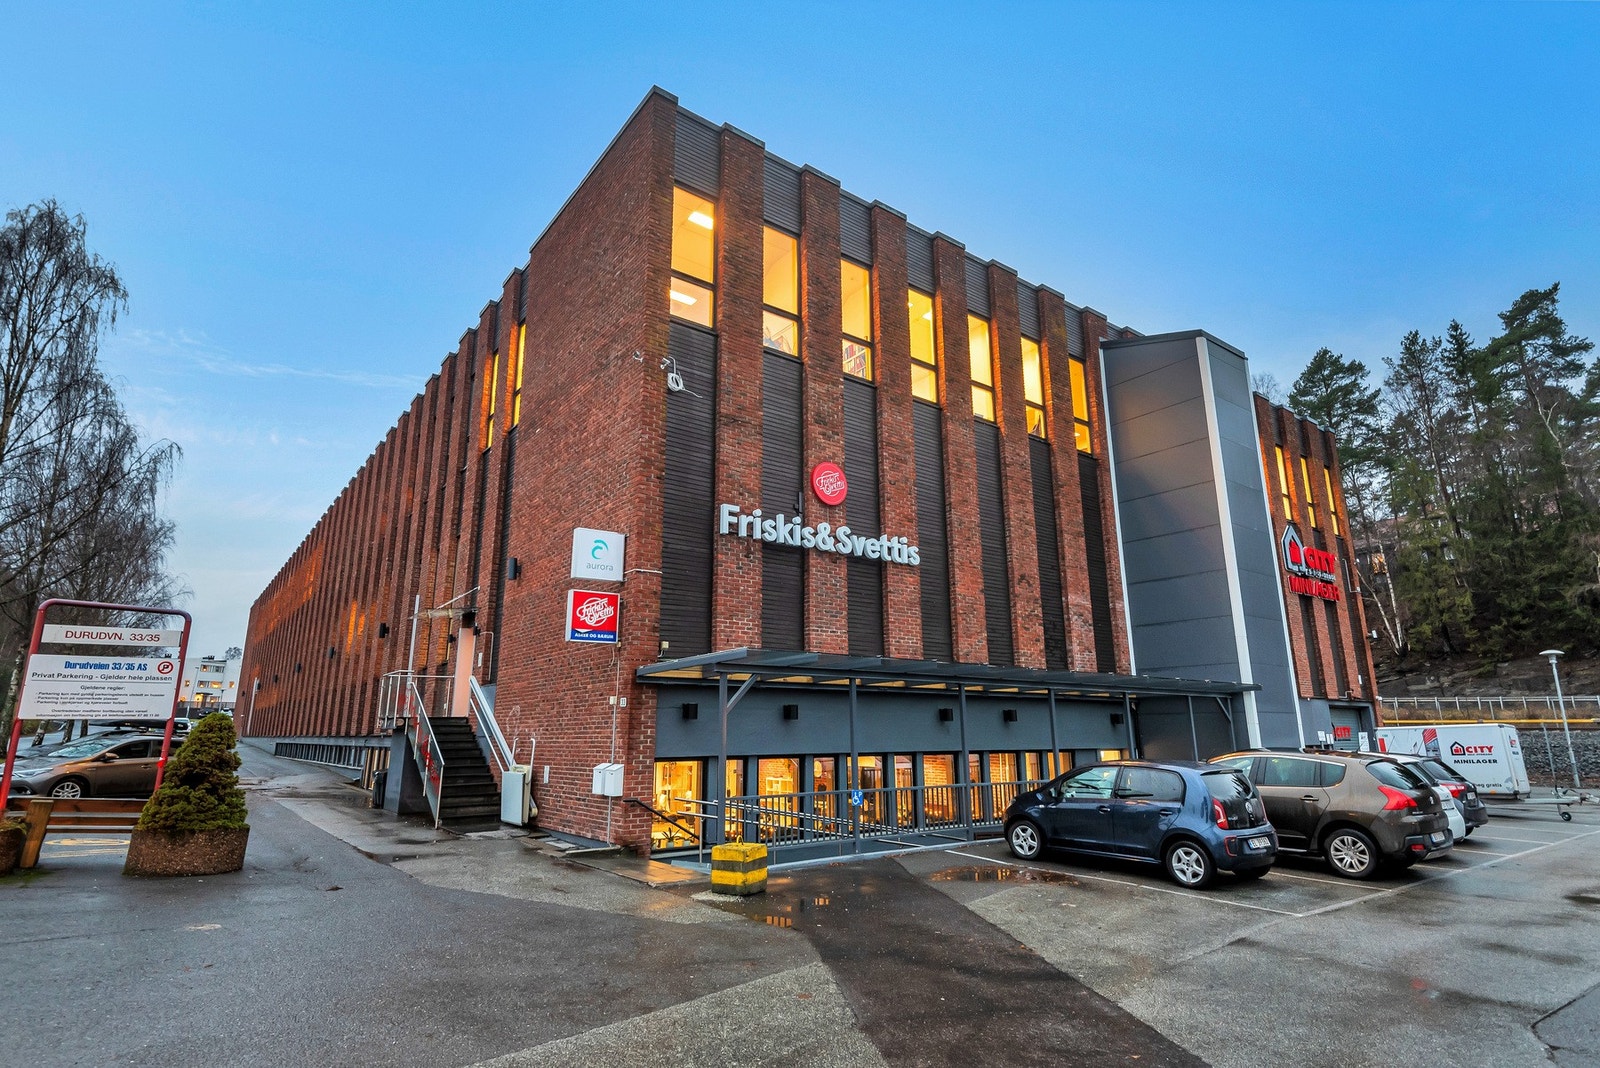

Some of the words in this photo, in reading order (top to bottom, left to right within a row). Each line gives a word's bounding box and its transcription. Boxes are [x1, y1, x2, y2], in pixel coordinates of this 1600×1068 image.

[720, 503, 920, 566] Friskis&Svettis
[1303, 546, 1337, 574] CITY
[586, 562, 614, 572] aurora
[65, 630, 124, 641] DURUDVN.
[129, 633, 160, 642] 33/35
[64, 660, 110, 670] Durudveien
[111, 662, 136, 671] 33/35
[136, 663, 148, 671] AS
[56, 672, 94, 680] Parkering
[1465, 745, 1494, 754] CITY
